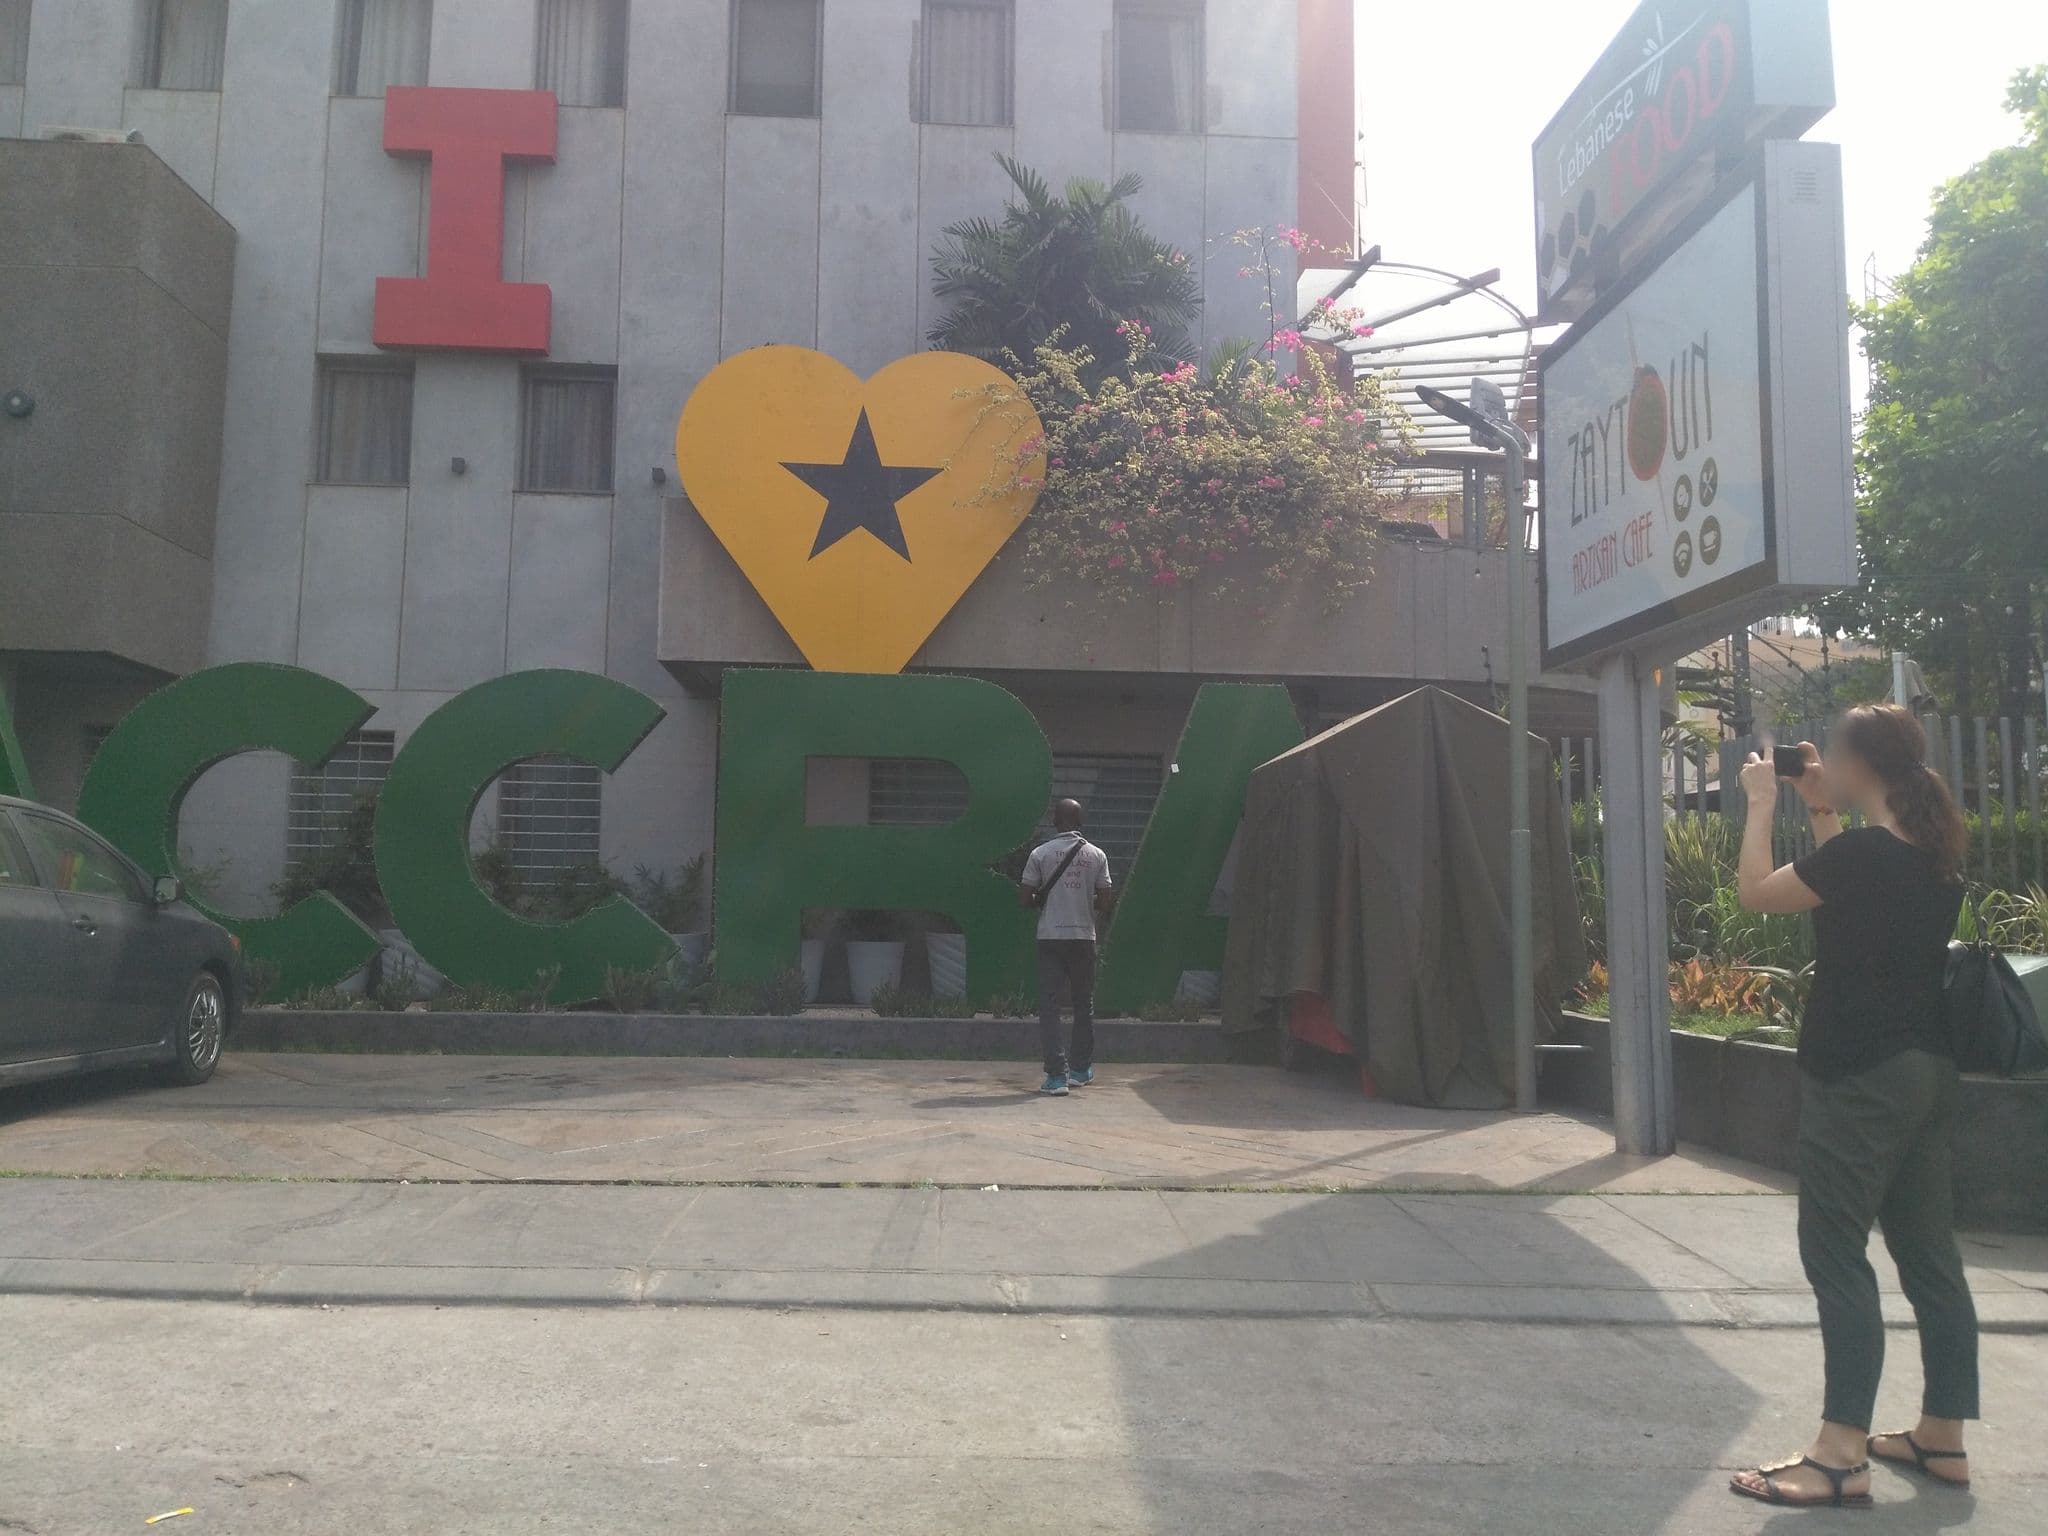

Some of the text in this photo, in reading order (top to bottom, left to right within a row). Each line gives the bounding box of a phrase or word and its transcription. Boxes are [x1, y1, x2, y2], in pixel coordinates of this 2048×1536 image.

[1557, 87, 1635, 198] Lebanese
[1611, 22, 1735, 217] FOOD
[373, 86, 558, 357] I
[1573, 511, 1654, 597] ARTISAN CAFE
